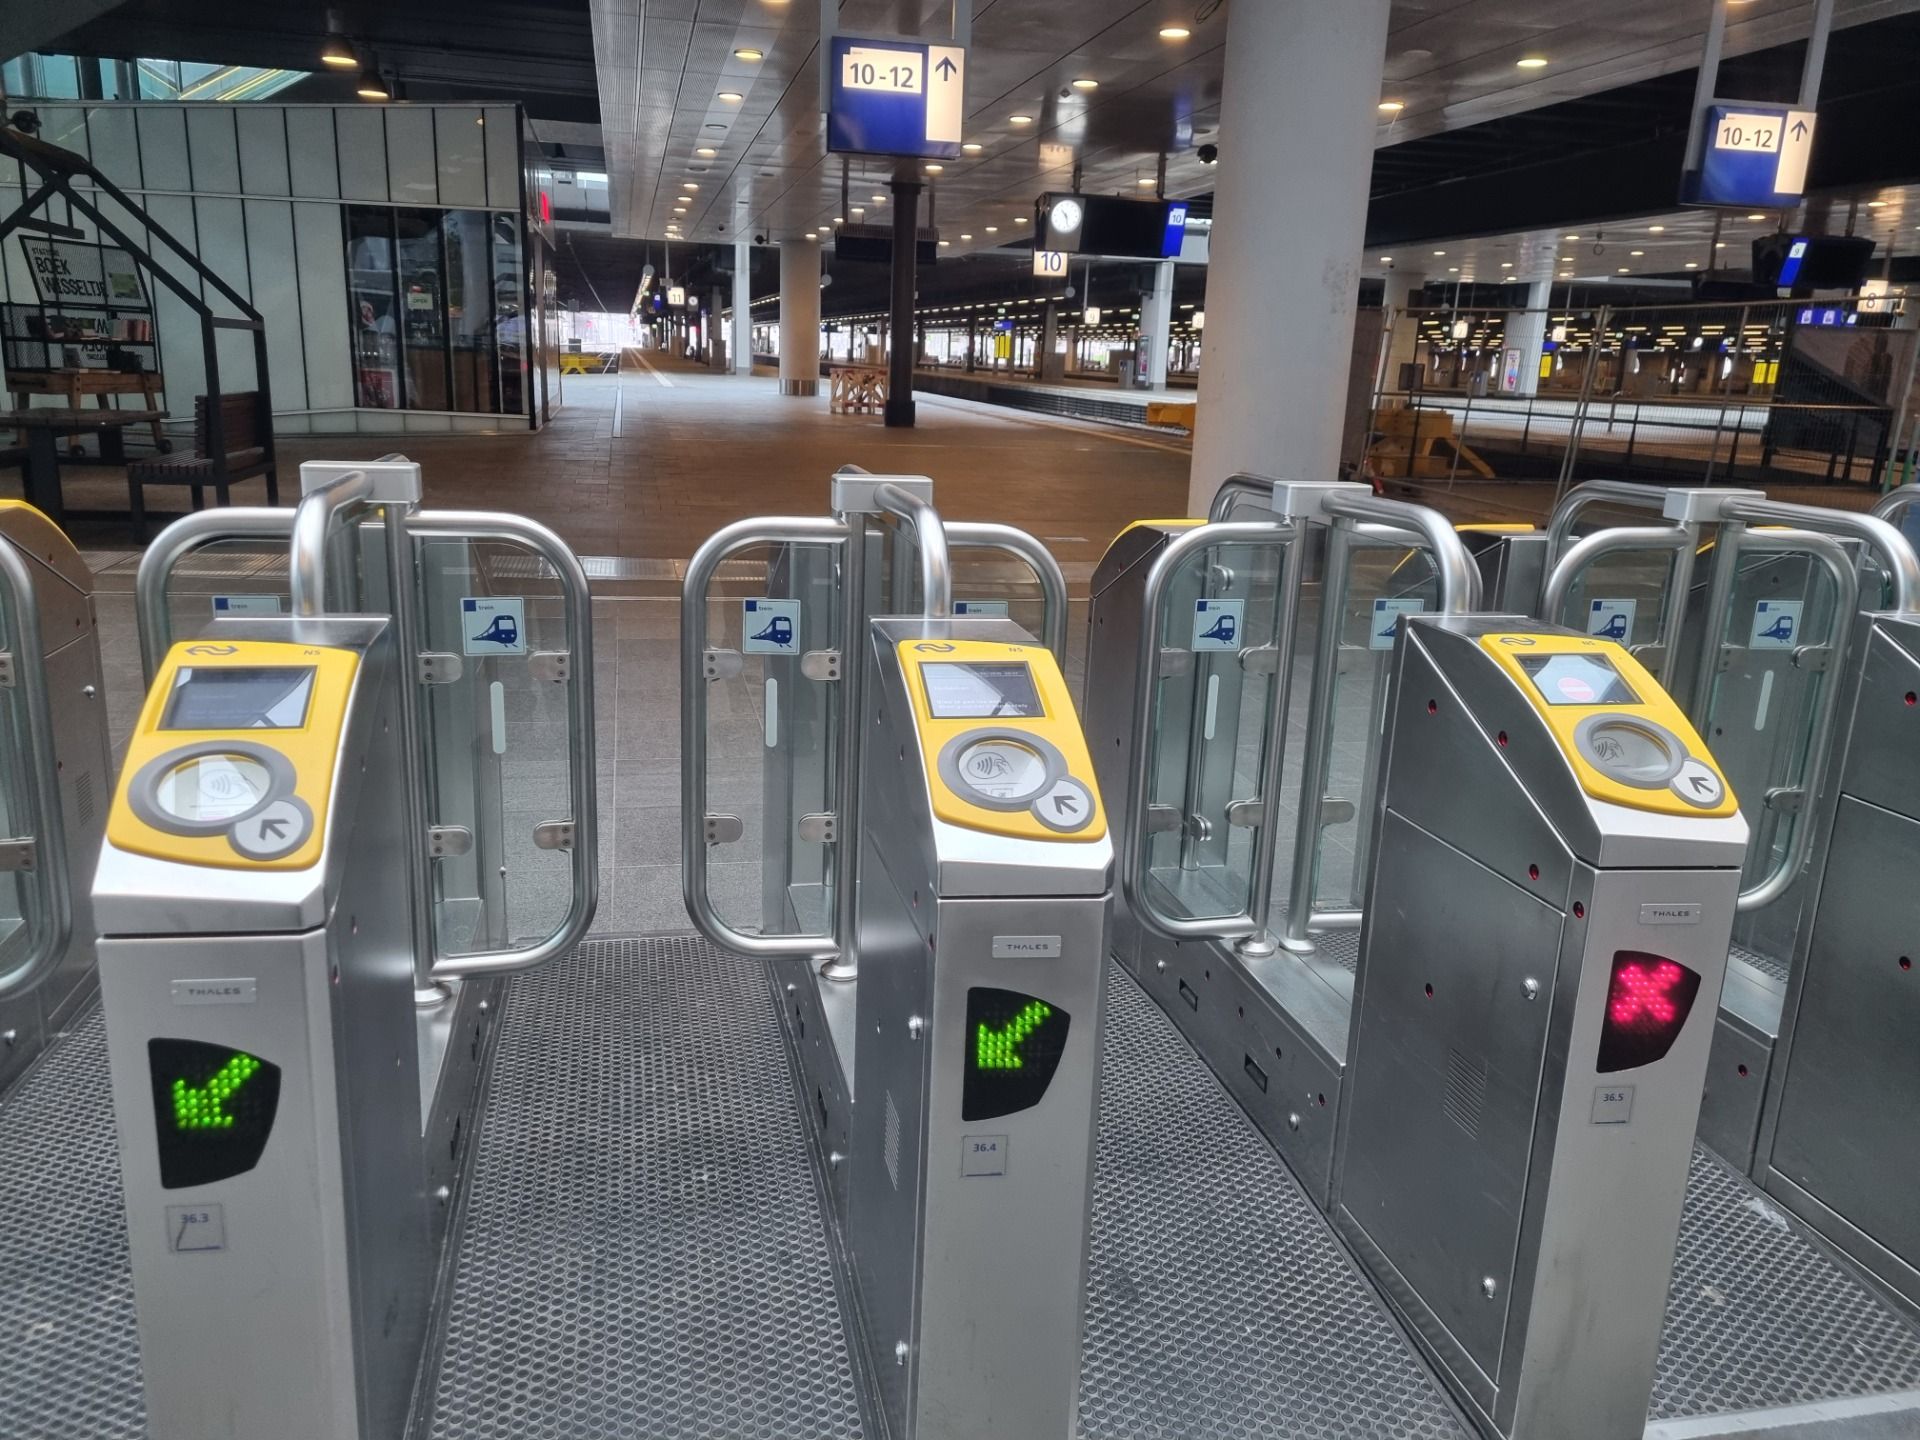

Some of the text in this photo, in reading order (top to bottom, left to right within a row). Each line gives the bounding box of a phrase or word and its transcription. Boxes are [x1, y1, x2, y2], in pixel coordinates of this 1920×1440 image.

[850, 62, 914, 88] 10-12
[1723, 127, 1773, 148] 10-12
[1172, 214, 1182, 224] 10
[1040, 252, 1062, 272] 10
[1866, 292, 1877, 309] 8
[1007, 943, 1049, 951] THALES
[188, 987, 241, 996] THALES
[1603, 1093, 1624, 1102] 36.5
[973, 1143, 997, 1153] 36.4
[180, 1213, 209, 1224] 36.3
